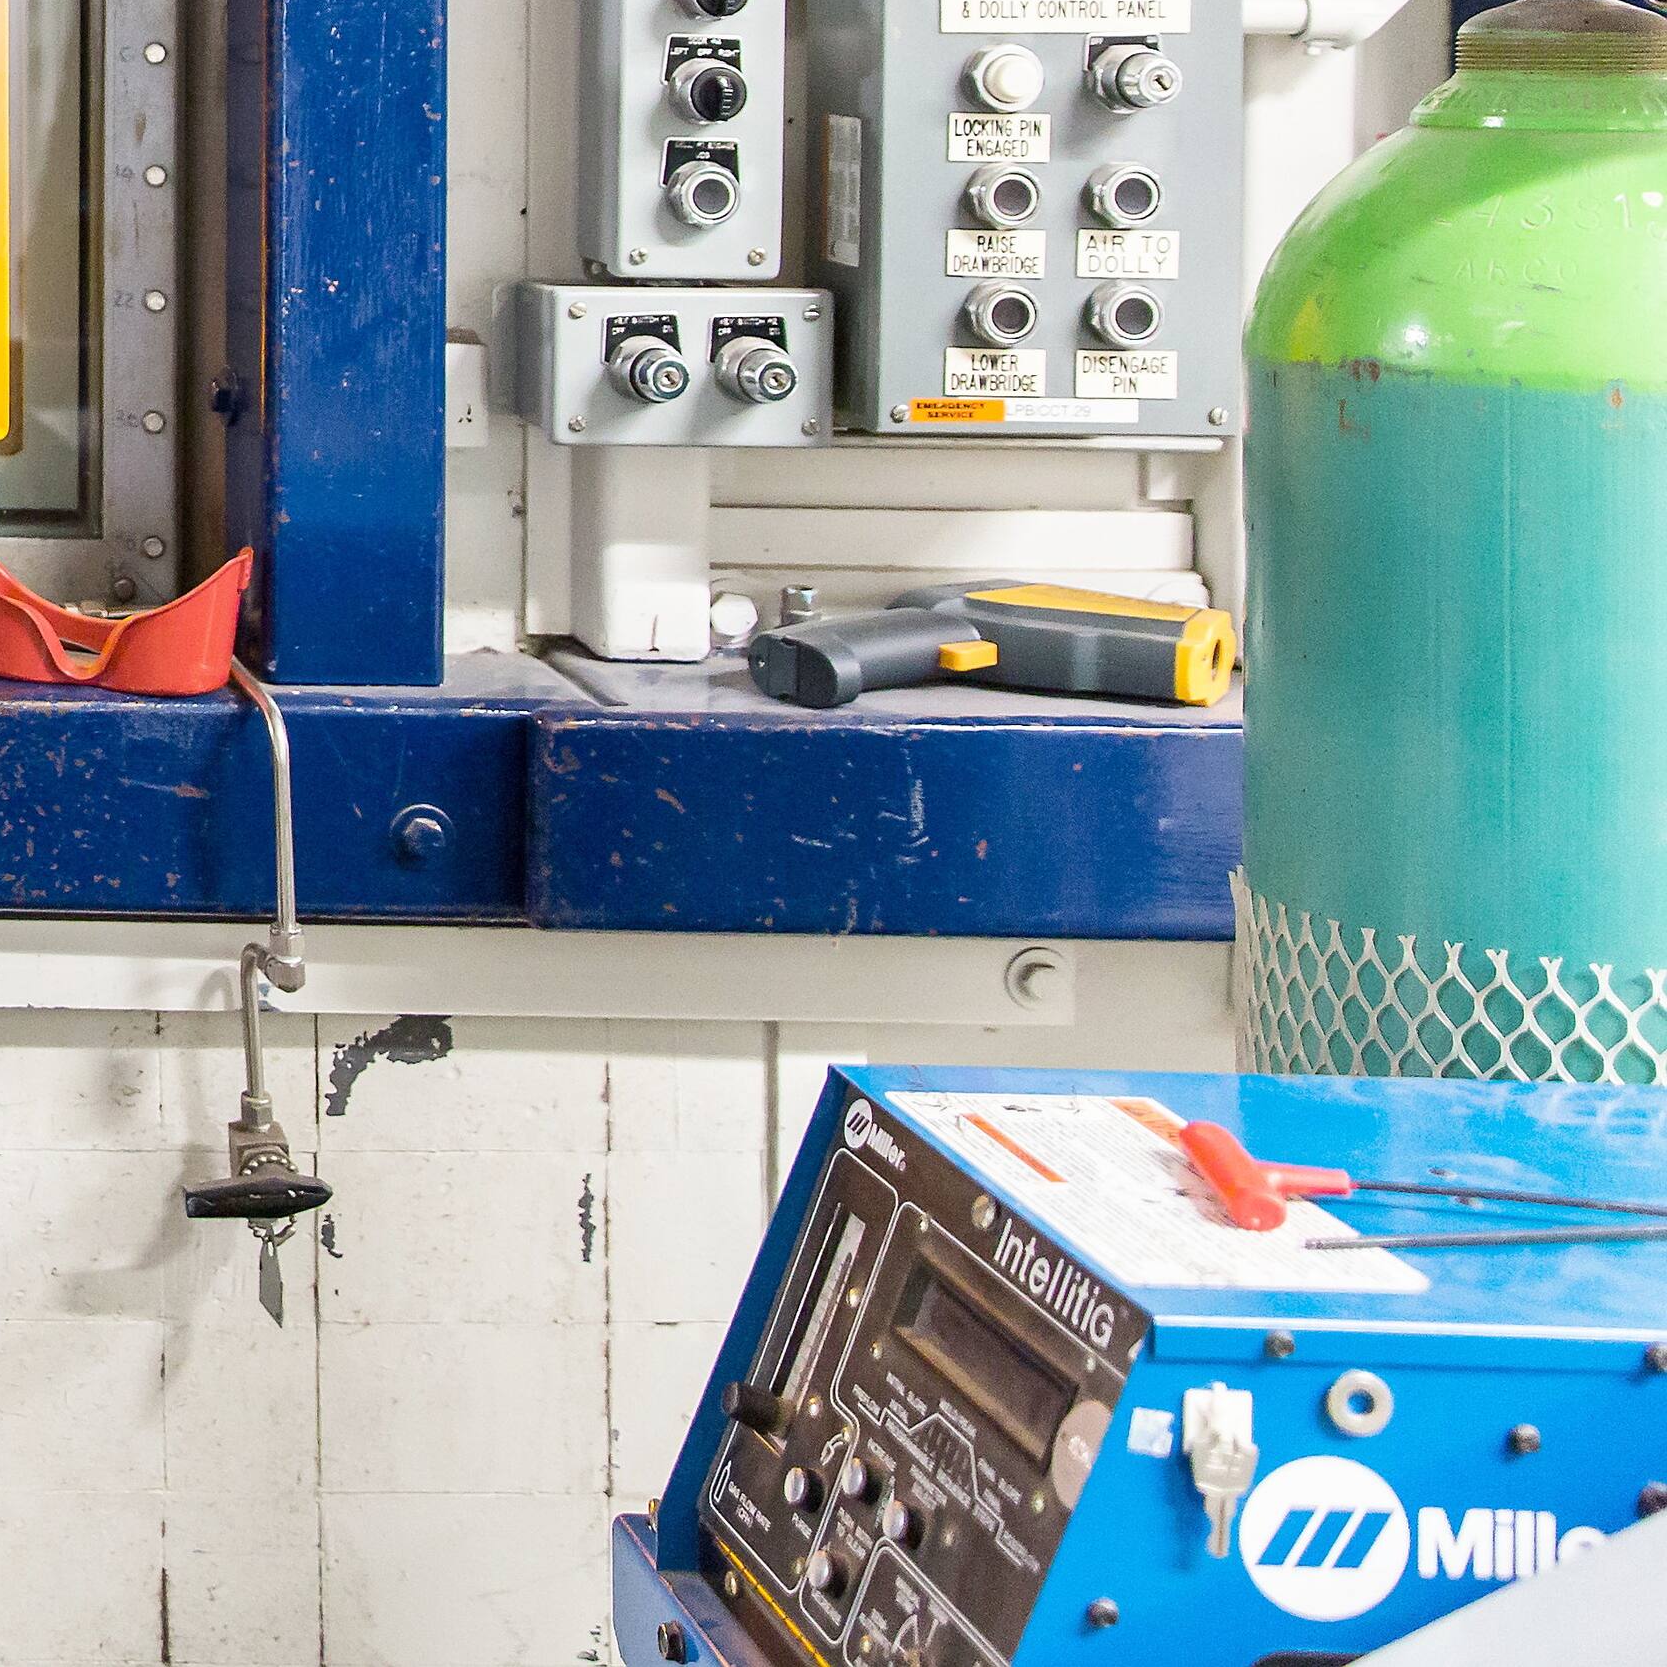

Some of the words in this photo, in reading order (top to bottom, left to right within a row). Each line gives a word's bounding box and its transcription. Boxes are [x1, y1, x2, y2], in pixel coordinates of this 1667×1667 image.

[962, 1, 970, 18] &
[979, 1, 1029, 18] DOLLY
[1038, 1, 1109, 19] CONTROL
[1117, 1, 1167, 19] PANEL
[954, 119, 1013, 137] LOCKING
[1020, 119, 1042, 137] PIN
[967, 139, 1029, 158] ENGAGED
[976, 235, 1017, 253] RAISE
[1085, 235, 1125, 253] AIR
[1141, 235, 1171, 253] TO
[953, 255, 1040, 274] DRAWBRIDGE
[1088, 255, 1167, 273] DOLLY
[971, 353, 1018, 372] LOWER
[1082, 356, 1169, 374] DISENGAGE
[951, 374, 1038, 392] DRAWBRIDGE
[1113, 376, 1138, 394] PIN
[927, 411, 974, 419] SERVICE
[867, 1122, 905, 1170] Miller
